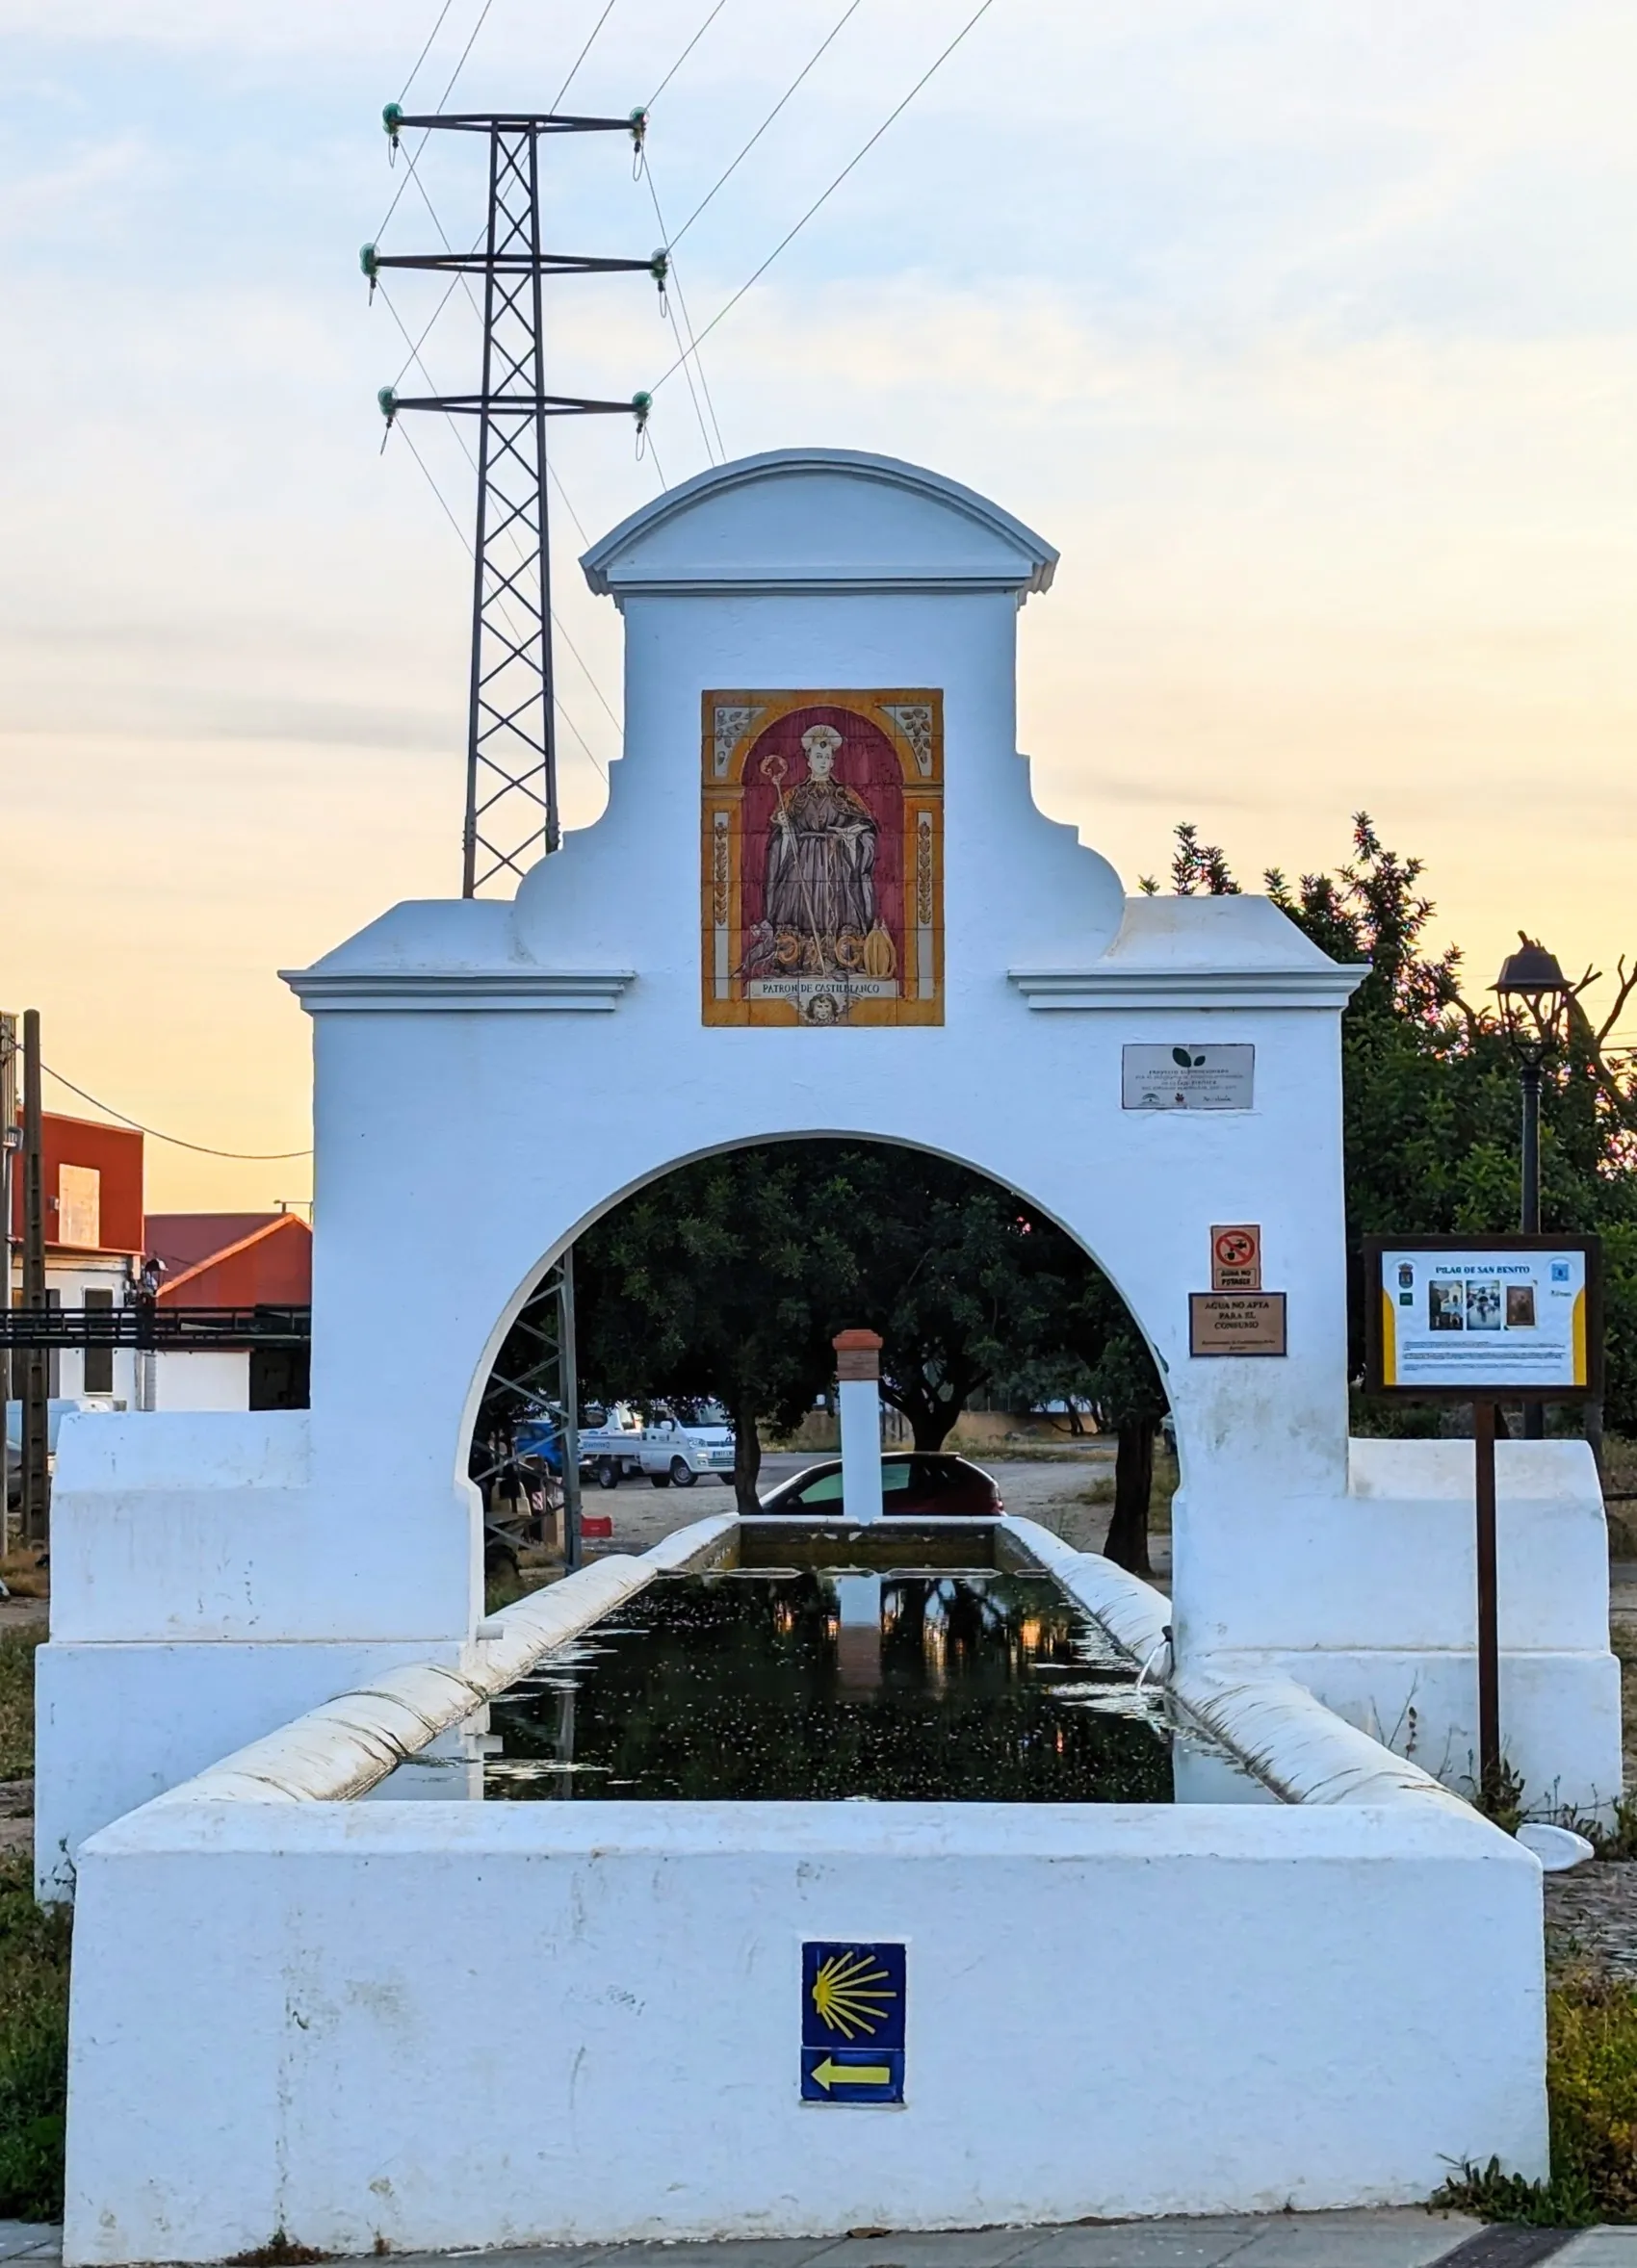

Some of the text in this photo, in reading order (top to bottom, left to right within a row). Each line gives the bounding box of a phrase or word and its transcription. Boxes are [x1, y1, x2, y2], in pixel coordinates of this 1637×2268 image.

[763, 984, 880, 994] PATRON DE CASTILBLANCO
[1436, 1266, 1462, 1275] PILAR
[1205, 1301, 1269, 1310] AGUA NO APTA
[1219, 1311, 1242, 1320] PARA
[1214, 1321, 1260, 1329] CONSUMO
